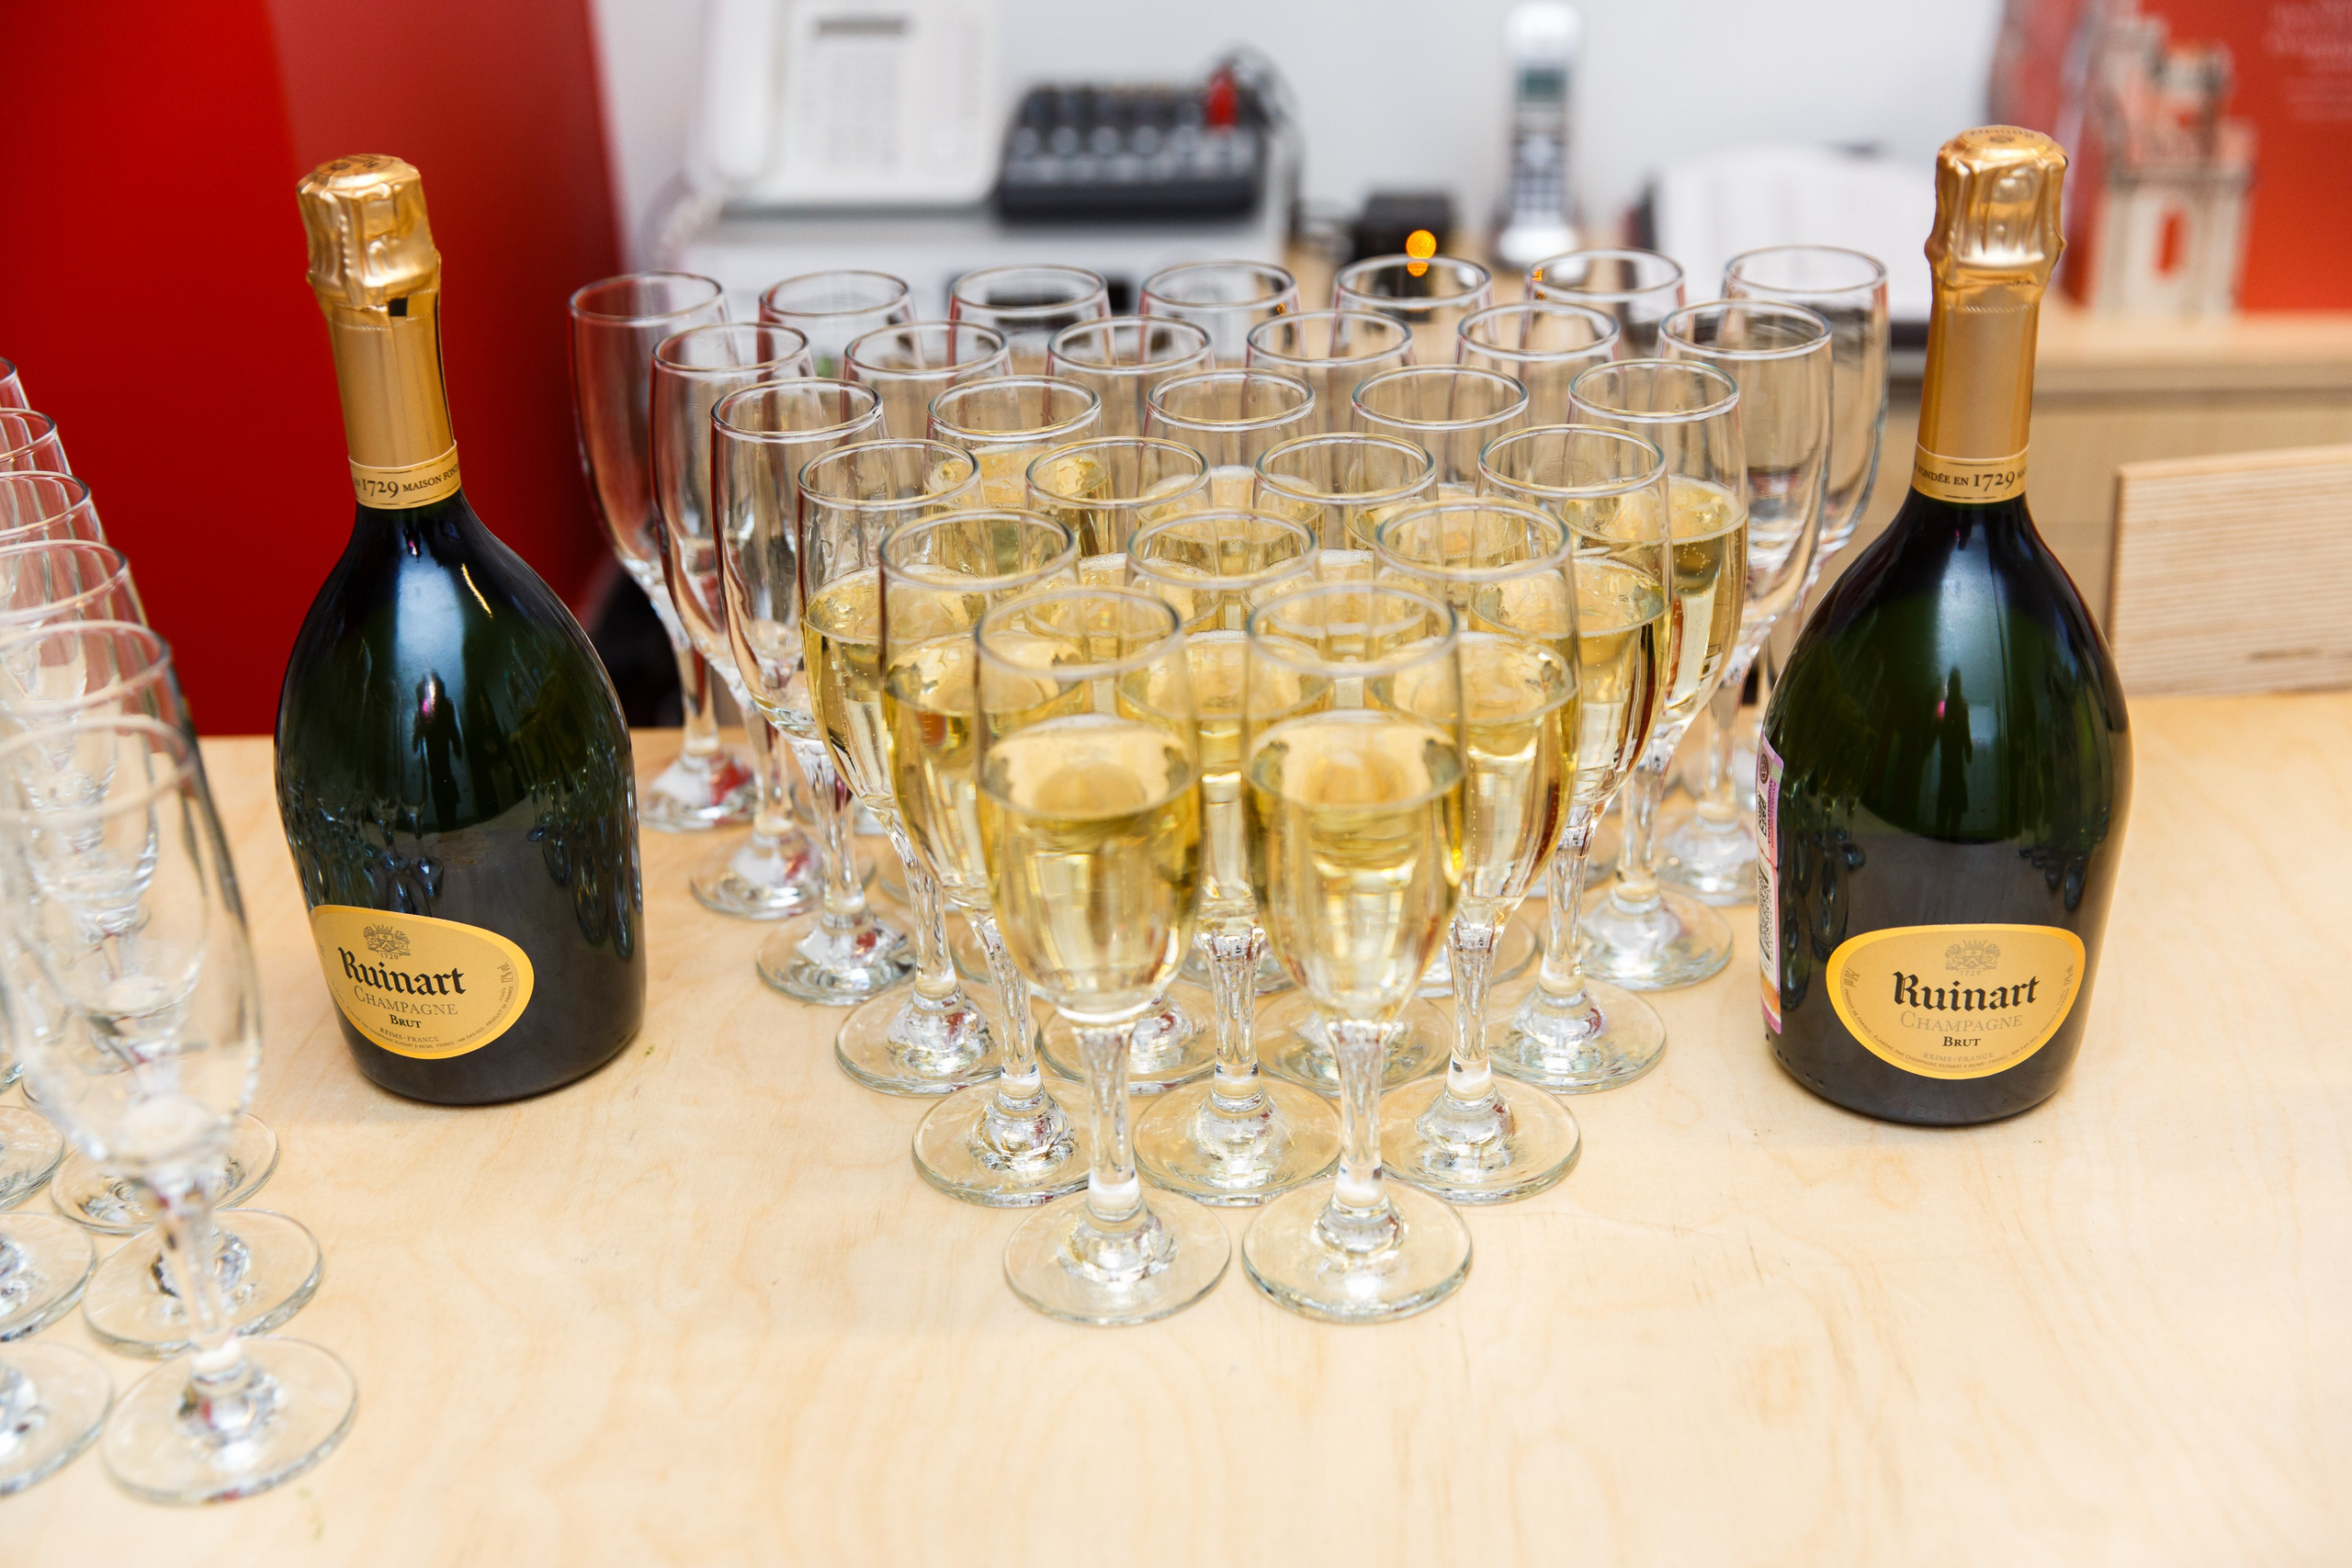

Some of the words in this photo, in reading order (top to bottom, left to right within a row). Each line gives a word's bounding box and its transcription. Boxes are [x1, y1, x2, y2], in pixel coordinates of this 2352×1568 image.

[362, 479, 399, 498] 1729
[402, 475, 442, 491] MAISON
[1917, 465, 1951, 484] FONDÉE
[1953, 477, 1969, 486] EN
[1974, 471, 2015, 492] 1729
[337, 946, 466, 996] Ruinart
[354, 985, 458, 1015] CHAMPAGNE
[1893, 971, 2041, 1011] Ruinart
[389, 1014, 422, 1029] BRUT
[1900, 1011, 2023, 1032] CHAMPAGNE
[379, 1027, 402, 1040] REIMS
[1942, 1036, 1981, 1047] BRUT
[1923, 1053, 1952, 1062] REIMS
[1958, 1052, 1994, 1063] FRANCE
